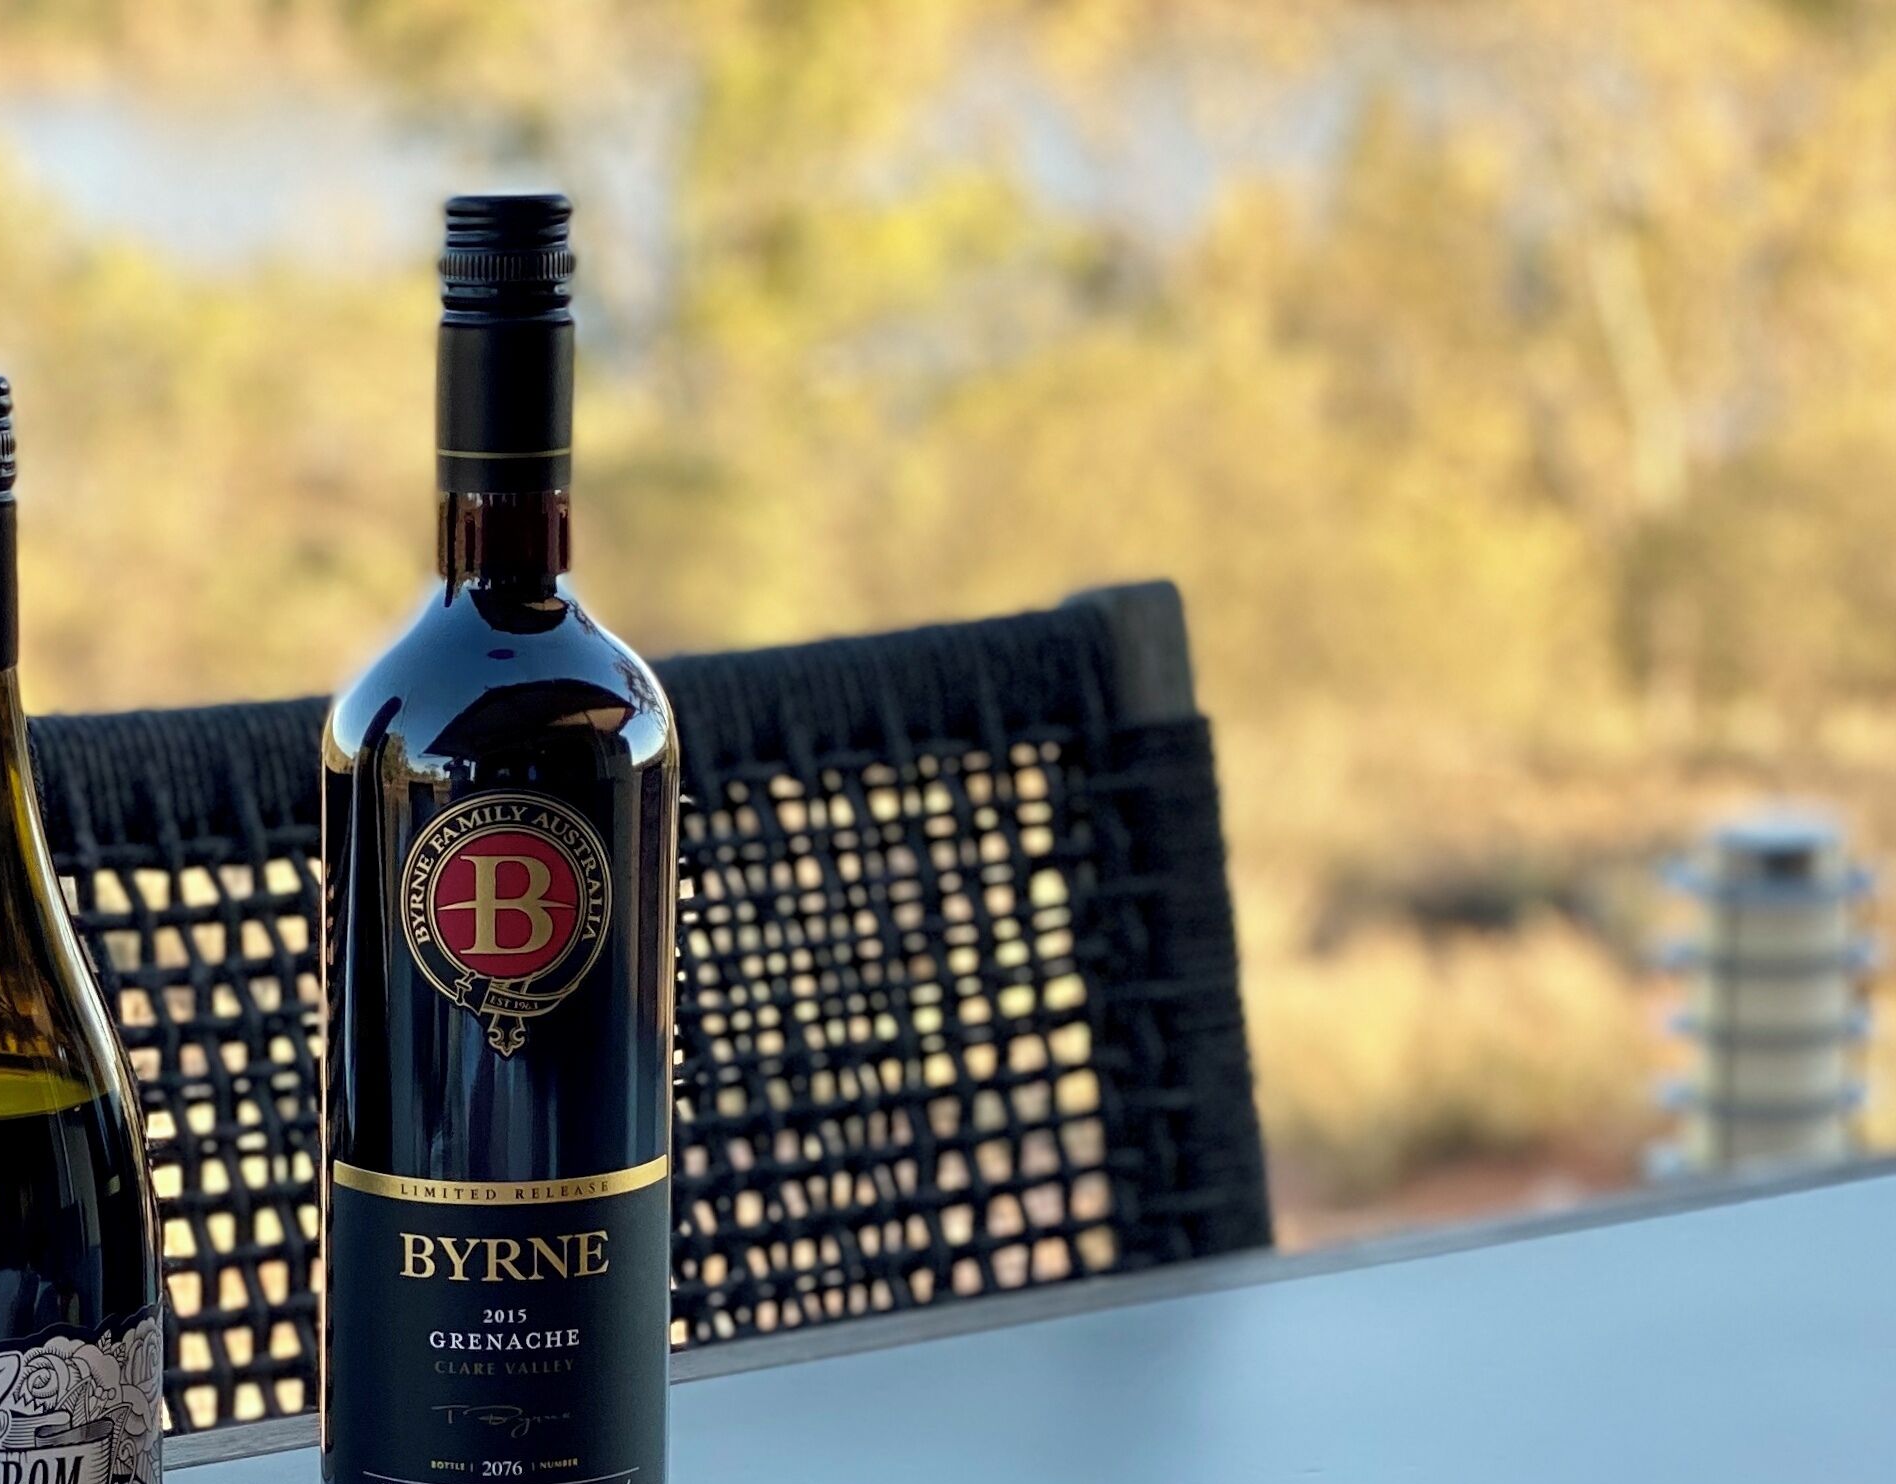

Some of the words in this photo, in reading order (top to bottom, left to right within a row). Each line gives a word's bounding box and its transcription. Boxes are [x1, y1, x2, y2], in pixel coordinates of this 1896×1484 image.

[409, 853, 435, 945] BYRNE
[429, 804, 528, 854] FAMILY
[532, 811, 602, 942] AUSTRALIA
[460, 855, 554, 955] B
[490, 995, 511, 1008] EST
[400, 1184, 497, 1200] LIMITED
[515, 1181, 610, 1200] RELEASE
[400, 1231, 610, 1282] BYRNE
[483, 1309, 528, 1324] 2015
[429, 1329, 581, 1351] GRENACHE
[434, 1360, 496, 1376] CLARE
[506, 1359, 575, 1375] VALLEY
[430, 1460, 465, 1472] BOTTLE
[482, 1460, 523, 1477] 2076
[539, 1458, 579, 1470] NUMBER
